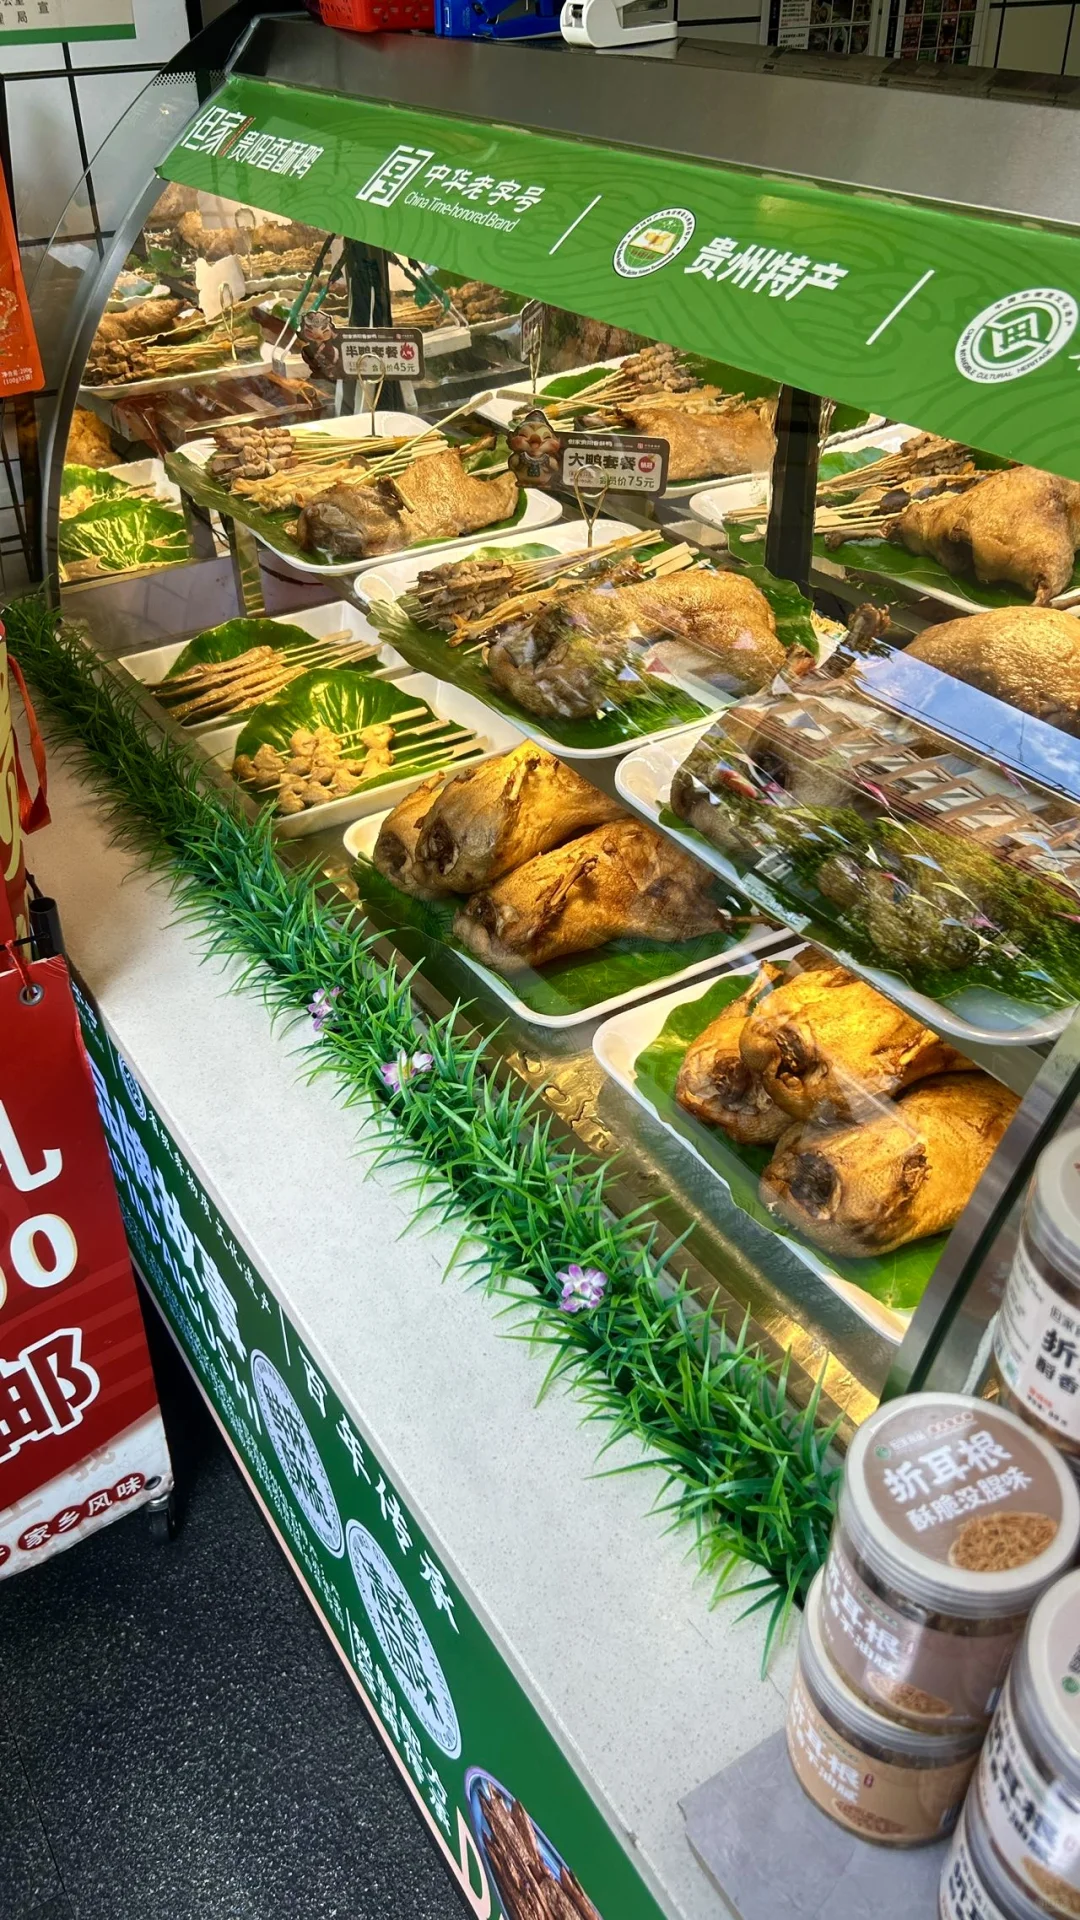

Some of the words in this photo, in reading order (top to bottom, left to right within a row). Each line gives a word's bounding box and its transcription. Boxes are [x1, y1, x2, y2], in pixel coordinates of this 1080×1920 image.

[227, 131, 325, 180] 贵阳香酥鸭
[424, 164, 546, 213] 中华老字号
[404, 191, 429, 208] China
[427, 197, 490, 226] Time-honored
[486, 213, 520, 233] Brand
[684, 237, 849, 301] 贵州特产
[346, 345, 398, 359] 半鸭套餐
[568, 453, 636, 471] 大鸭套餐
[85, 1049, 247, 1363] 品牌故事
[299, 1346, 460, 1635] 百年传承
[883, 1430, 1013, 1504] 折耳根
[905, 1466, 1033, 1533] 酥脆没腥味
[24, 1476, 142, 1549] 家乡风味
[358, 1550, 422, 1660] 清香
[377, 1610, 443, 1724] 回味
[353, 1620, 448, 1807] 秘制配方
[356, 1650, 451, 1837] 经典传承
